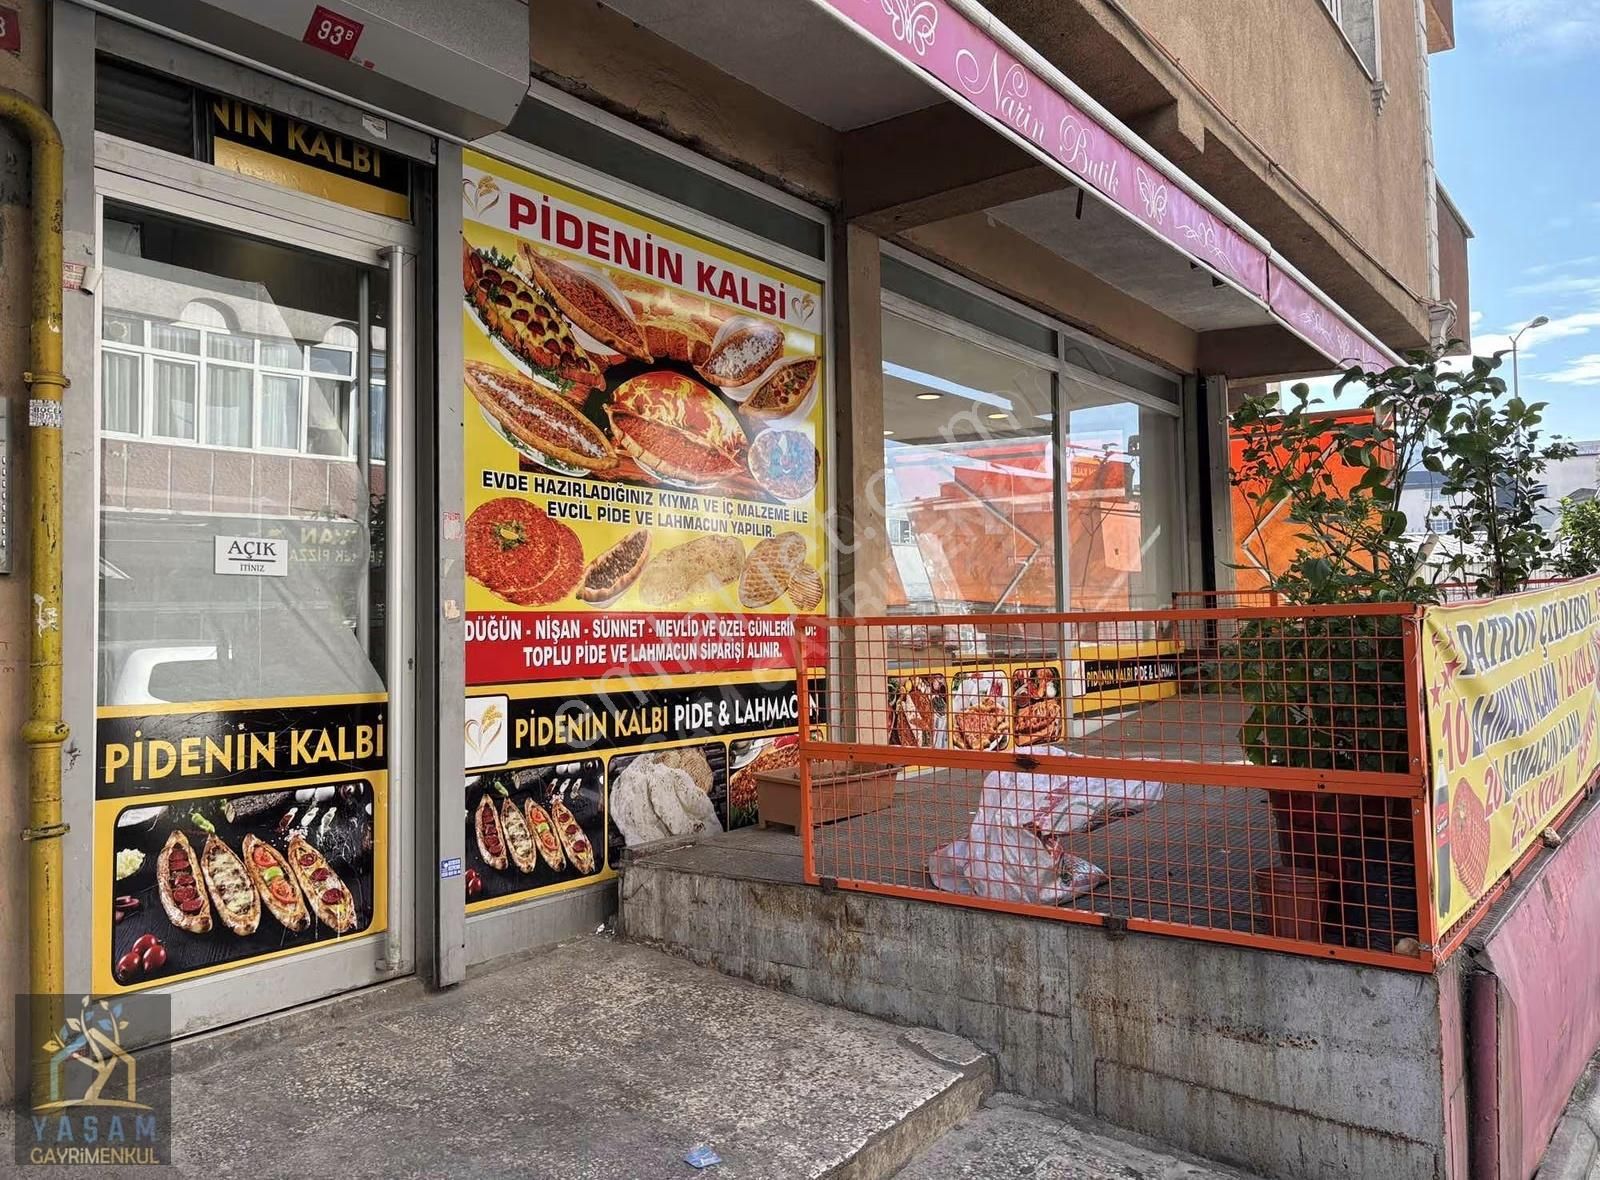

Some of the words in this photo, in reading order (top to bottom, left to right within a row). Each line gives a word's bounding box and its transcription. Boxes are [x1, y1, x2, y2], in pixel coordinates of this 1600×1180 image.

[1059, 115, 1119, 194] Butik
[508, 191, 684, 287] PİDENİN
[697, 259, 786, 321] KALBİ
[482, 470, 528, 491] EVDE
[534, 477, 653, 507] HAZIRLADIĞINIZ
[658, 492, 700, 511] KIYMA
[703, 498, 719, 513] VE
[722, 496, 734, 517] İÇ
[737, 503, 790, 523] MALZEME
[792, 506, 808, 524] İLE
[547, 499, 593, 521] EVCİL
[598, 504, 631, 524] PİDE
[635, 510, 653, 526] VE
[657, 513, 728, 534] LAHMACUN
[731, 520, 776, 539] YAPILIR.
[228, 540, 277, 560] AÇIK
[465, 615, 522, 642] DÜĞÜN
[535, 615, 581, 645] NİŞAN
[592, 616, 646, 639] SÜNNET
[656, 615, 699, 638] MEVLİD
[700, 619, 717, 637] VE
[719, 616, 745, 637] ÖZEL
[523, 644, 571, 668] TOPLU
[576, 642, 606, 665] PİDE
[610, 645, 628, 663] VE
[631, 642, 697, 663] LAHMACUN
[699, 639, 745, 664] SİPARİŞİ
[746, 641, 784, 659] ALINIR.
[1456, 609, 1537, 676] PATRON
[104, 722, 276, 785] PİDENİN
[290, 713, 384, 766] KALBİ
[514, 704, 608, 750] PİDENİN
[614, 698, 669, 738] KALBİ
[674, 696, 713, 731] PİDE
[718, 703, 730, 728] &
[1442, 697, 1470, 773] 10
[1484, 766, 1503, 822] 20
